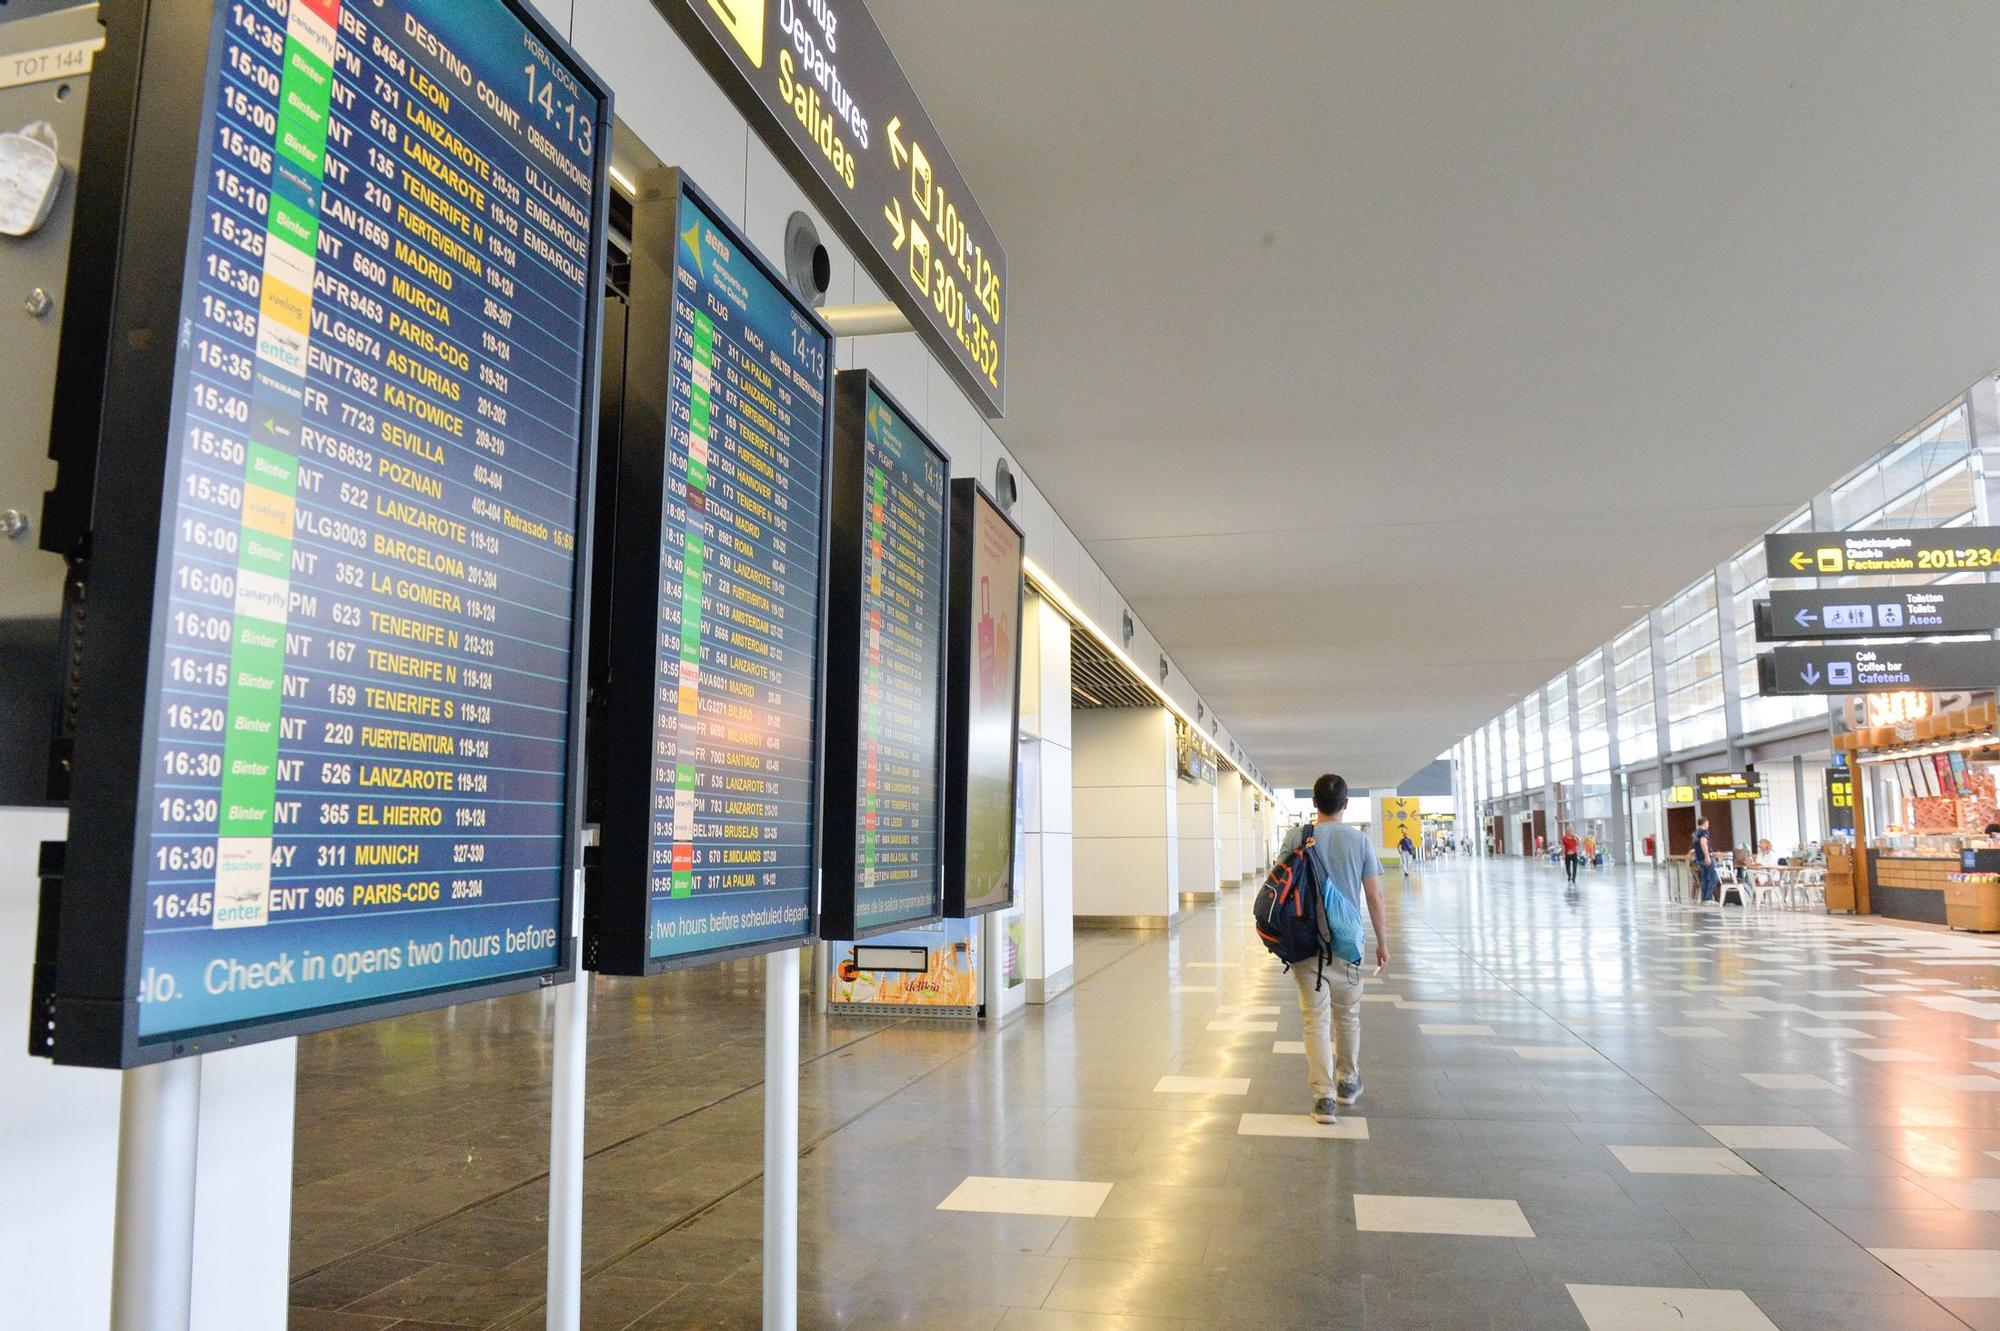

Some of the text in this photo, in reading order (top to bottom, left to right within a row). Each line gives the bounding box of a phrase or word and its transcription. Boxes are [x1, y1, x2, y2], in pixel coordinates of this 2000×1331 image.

[13, 50, 83, 77] TOT 144
[404, 13, 592, 196] DESTINO COUNT. OBSERVACIONES
[523, 33, 579, 100] HORA LOCAL
[780, 0, 868, 149] Departures
[229, 46, 483, 245] 15:00 NT 135 TENERIFE N
[233, 4, 585, 288] 14:35 NT 518 LANZAROTE EMBARQUE
[334, 36, 586, 259] PM 731 LANZAROTE EMBARQUE
[337, 5, 590, 233] IBE 8464 LEON UL.LLAMADA
[524, 64, 592, 156] 14:13
[779, 49, 855, 190] Salidas
[220, 127, 452, 291] 15:05 LAN1559 MADRID
[225, 86, 482, 278] 15:00 NT 210 FUERTEVENTURA
[215, 169, 450, 326] 15:10 NT 5600 MURCIA
[705, 229, 730, 263] aena
[936, 187, 965, 274] 101
[975, 247, 1000, 325] 126
[207, 254, 460, 401] 15:30 VLG6574 ASTURIAS
[211, 212, 469, 372] 15:25 AFR9453 PARIS-CDG
[707, 292, 764, 353] FLUG NACH
[934, 259, 964, 343] 301
[971, 313, 998, 388] 352
[202, 295, 463, 437] 15:35 ENT7362 KATOWICE
[791, 328, 824, 381] 14:13
[198, 340, 444, 466] 15:35 FR 7723 SEVILLA
[190, 428, 466, 544] 15:50 NT 522 LANZAROTE
[194, 384, 548, 541] 15:40 RYS5832 POZNAN Retrasado
[182, 519, 461, 614] 16:00 NT 352 LA GOMERA
[186, 474, 464, 579] 15:50 VLG3003 BARCELONA
[1848, 558, 1913, 569] Facturación
[1918, 550, 1957, 568] 201
[174, 611, 456, 684] 16:00 NT 167 TENERIFE N
[178, 565, 458, 649] 16:00 PM 623 TENERIFE N
[1909, 615, 1942, 624] Aseos
[170, 657, 454, 719] 16:15 NT 159 TENERIFE S
[1857, 662, 1902, 672] Coffee bar
[1858, 673, 1910, 683] Cafetería
[163, 751, 453, 790] 16:30 NT 526 LANZAROTE
[167, 704, 454, 755] 16:20 NT 220 FUERTEVENTURA
[159, 798, 442, 826] 16:30 NT 365 EL HIERRO
[695, 772, 764, 793] NT 536 LANZAROTE
[156, 844, 419, 870] 16:30 4Y 311 MUNICH
[691, 874, 756, 890] NT 317 LA PALMA
[692, 850, 721, 864] LS 670
[153, 881, 440, 919] 16:45 ENT 906 PARIS-CDG
[656, 919, 676, 940] two
[678, 916, 707, 936] hours
[709, 911, 739, 933] before
[740, 906, 782, 929] scheduled
[203, 924, 556, 996] Check in opens two hours before
